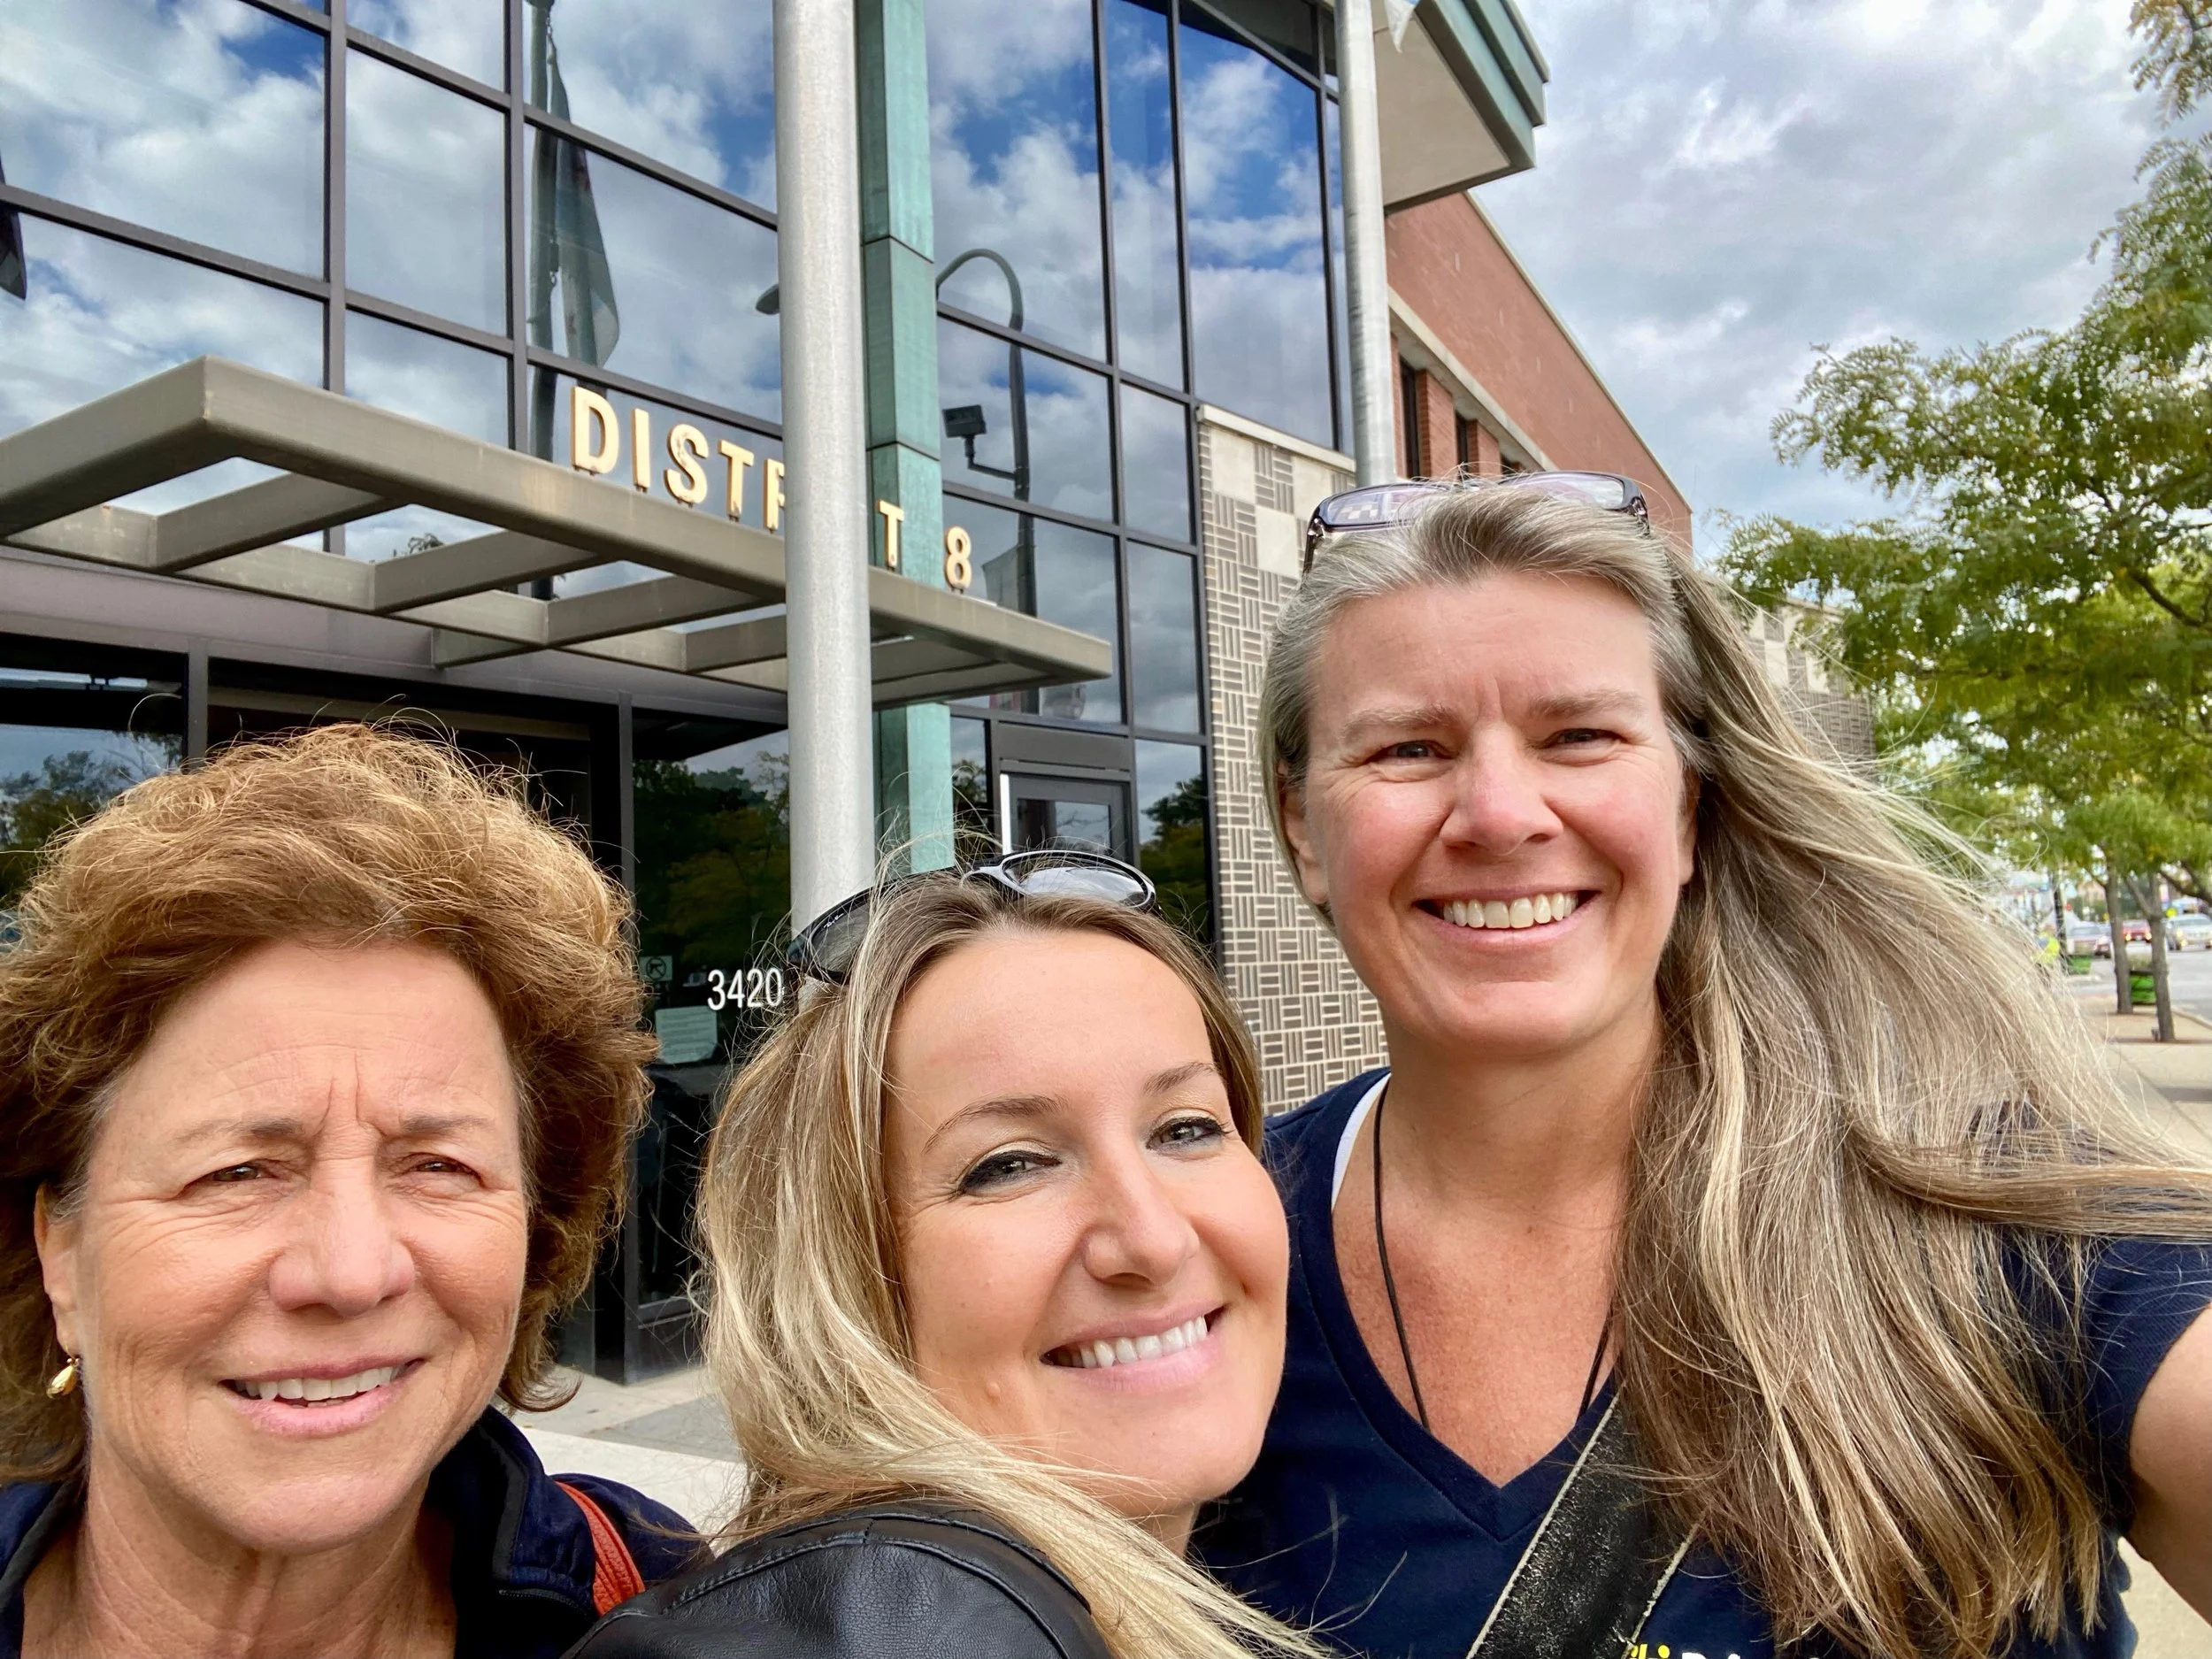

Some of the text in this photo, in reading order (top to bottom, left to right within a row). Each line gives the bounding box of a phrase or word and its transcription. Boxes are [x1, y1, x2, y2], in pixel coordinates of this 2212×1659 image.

[571, 386, 972, 589] DISTRT 8
[707, 968, 783, 1010] 3420
